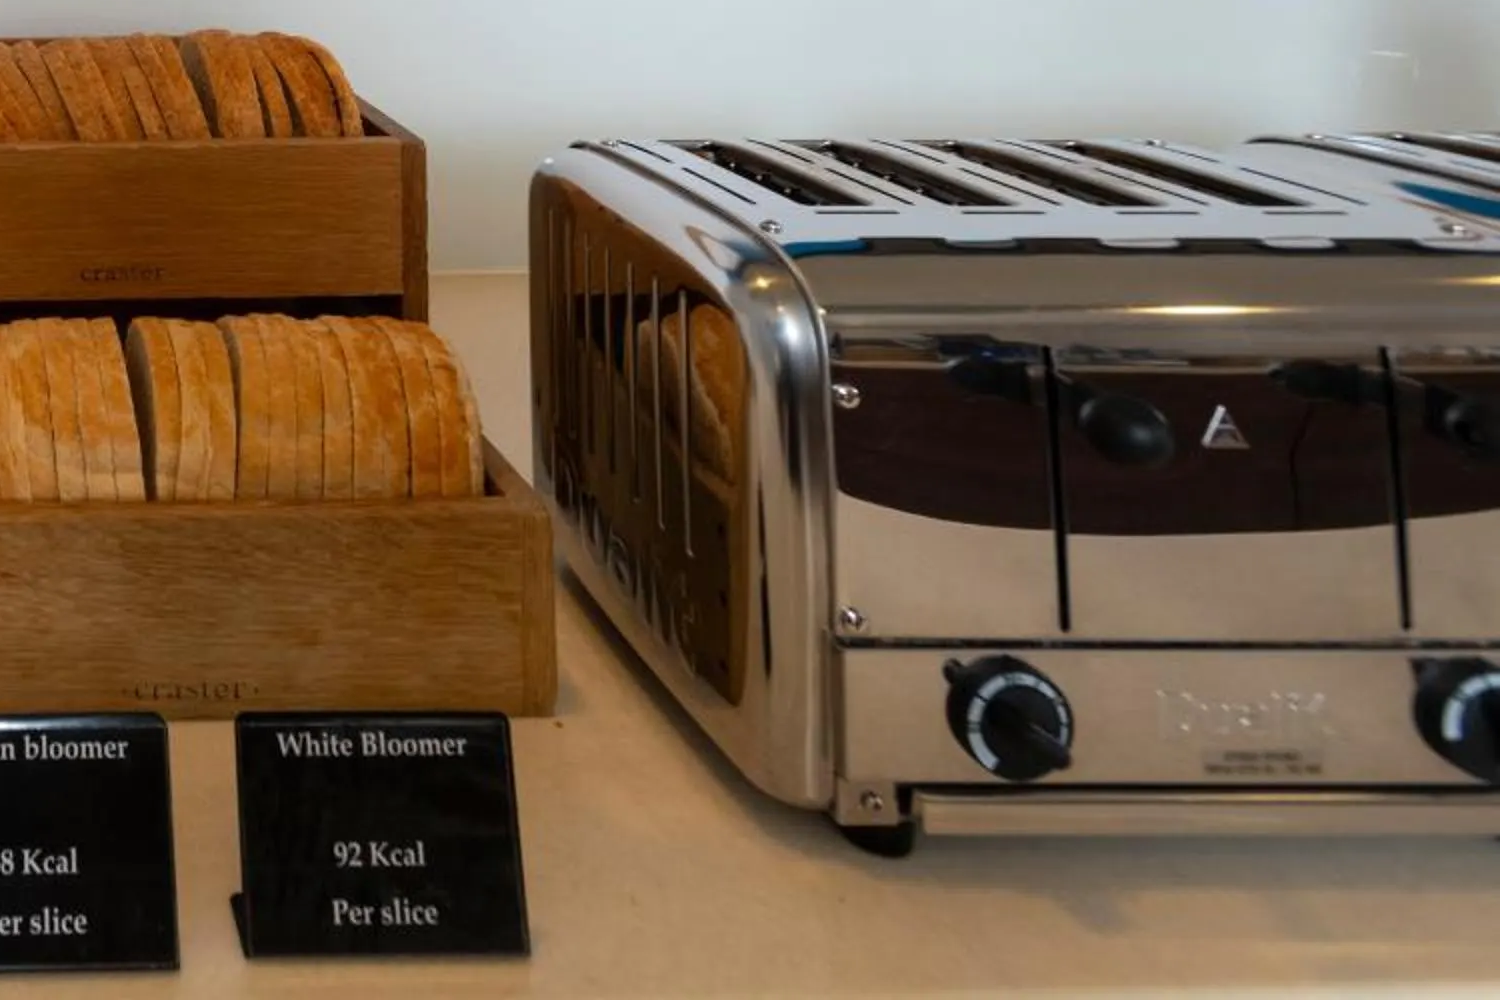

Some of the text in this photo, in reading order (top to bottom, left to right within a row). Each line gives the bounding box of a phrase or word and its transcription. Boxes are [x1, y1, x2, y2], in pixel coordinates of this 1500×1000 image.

[24, 735, 129, 760] bloomer
[276, 731, 468, 758] White Bloomer
[21, 847, 79, 875] Kcal
[333, 840, 425, 867] 92 Kcal
[29, 907, 88, 935] slice
[332, 897, 439, 926] Per slice
